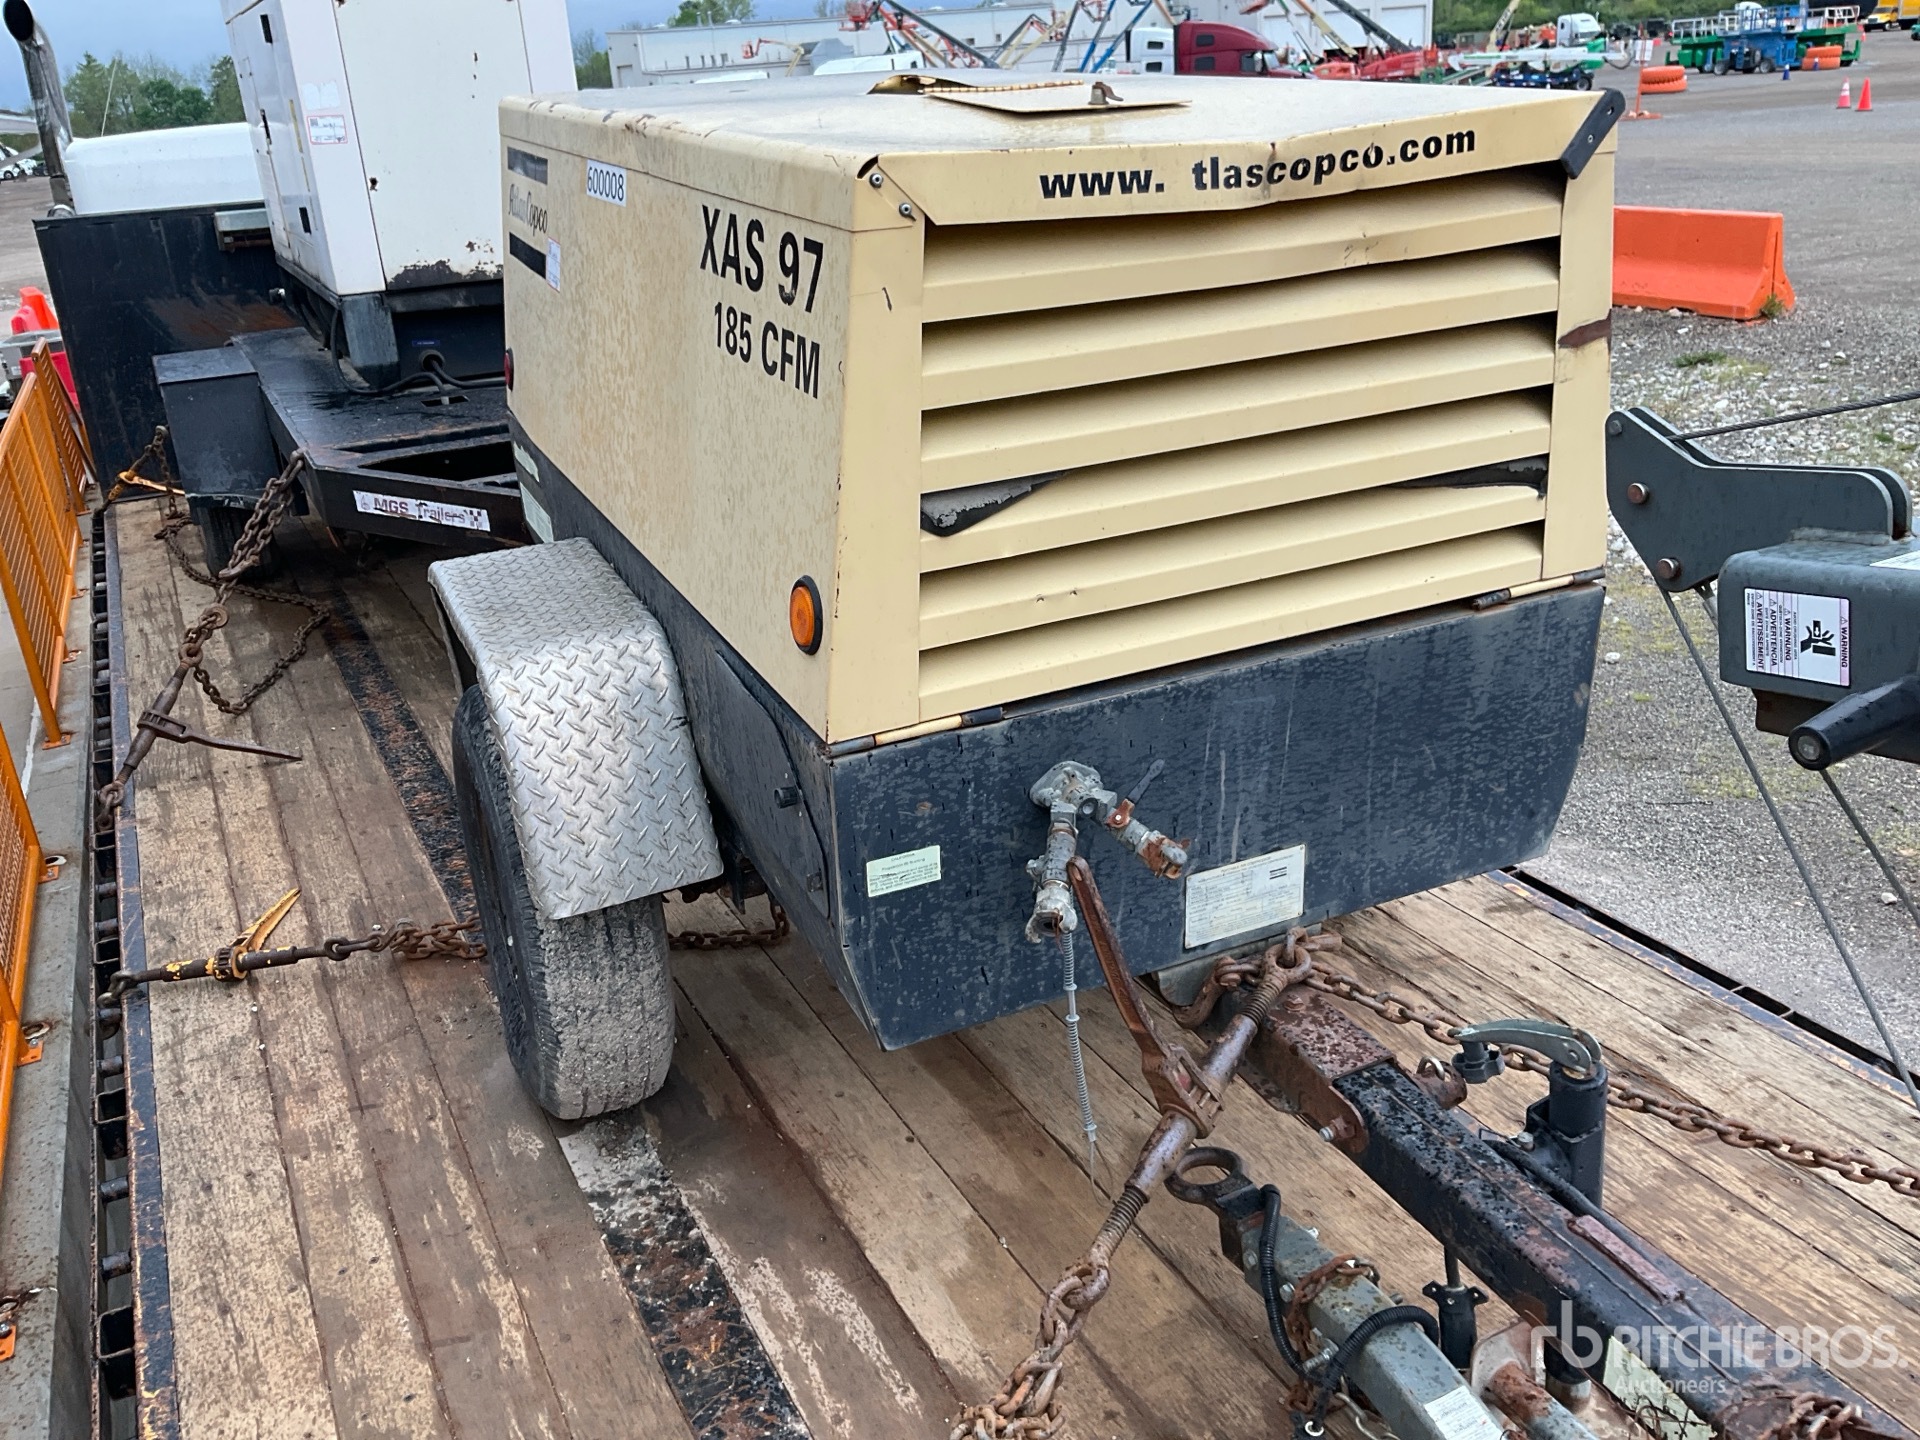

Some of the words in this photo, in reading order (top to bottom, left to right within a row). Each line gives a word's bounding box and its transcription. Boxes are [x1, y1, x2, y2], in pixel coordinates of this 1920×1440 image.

[587, 166, 624, 202] 600008
[1039, 169, 1165, 199] www.
[700, 204, 765, 292] XAS
[778, 231, 824, 313] 97
[714, 301, 752, 363] 185
[761, 320, 820, 399] CFM
[373, 497, 409, 514] MGS
[415, 501, 466, 524] Trailers
[1756, 602, 1765, 670] AVERTISSEMENT
[1769, 609, 1778, 667] ADVERTENCIA
[1784, 617, 1792, 661] WARNUNG
[1840, 626, 1849, 668] WARNING
